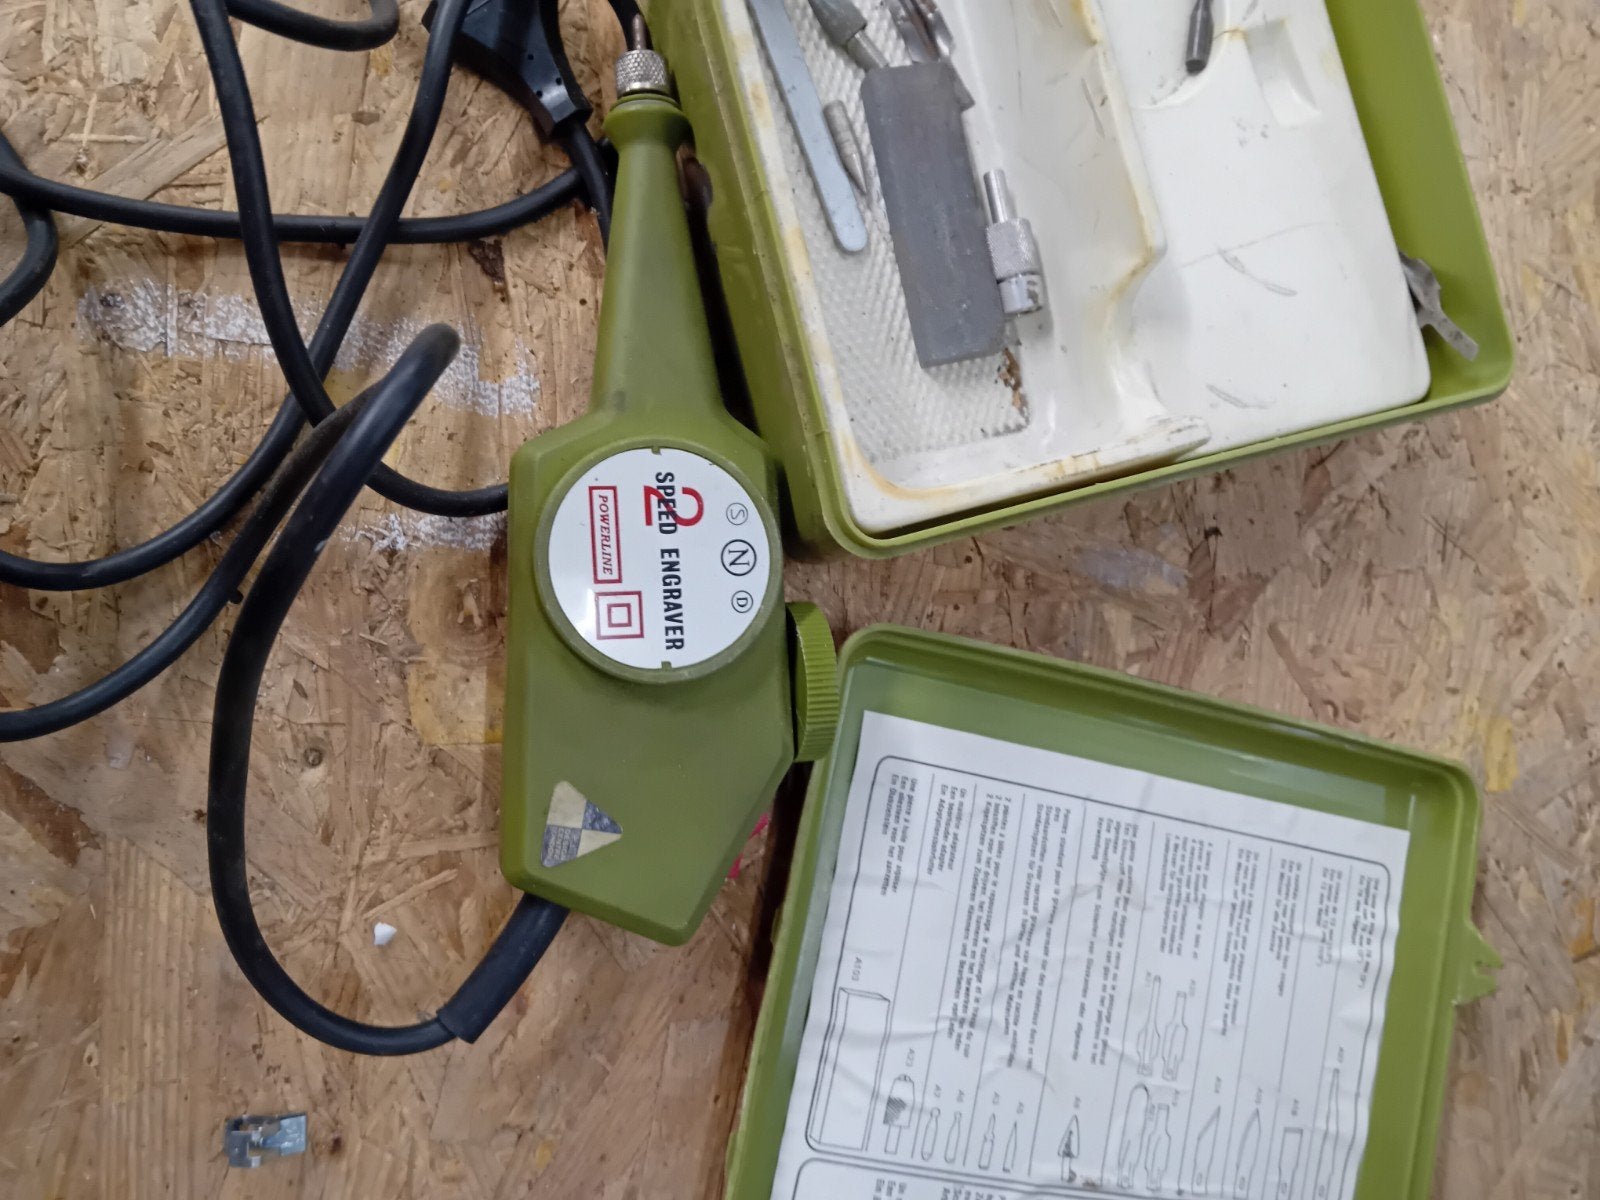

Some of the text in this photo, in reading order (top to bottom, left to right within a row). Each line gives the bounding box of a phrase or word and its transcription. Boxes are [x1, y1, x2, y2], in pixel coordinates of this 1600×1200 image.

[643, 485, 705, 527] 2
[598, 494, 613, 576] POWERLINE
[655, 471, 685, 651] SPEED ENGRAVER
[727, 547, 750, 567] N
[735, 596, 748, 608] D
